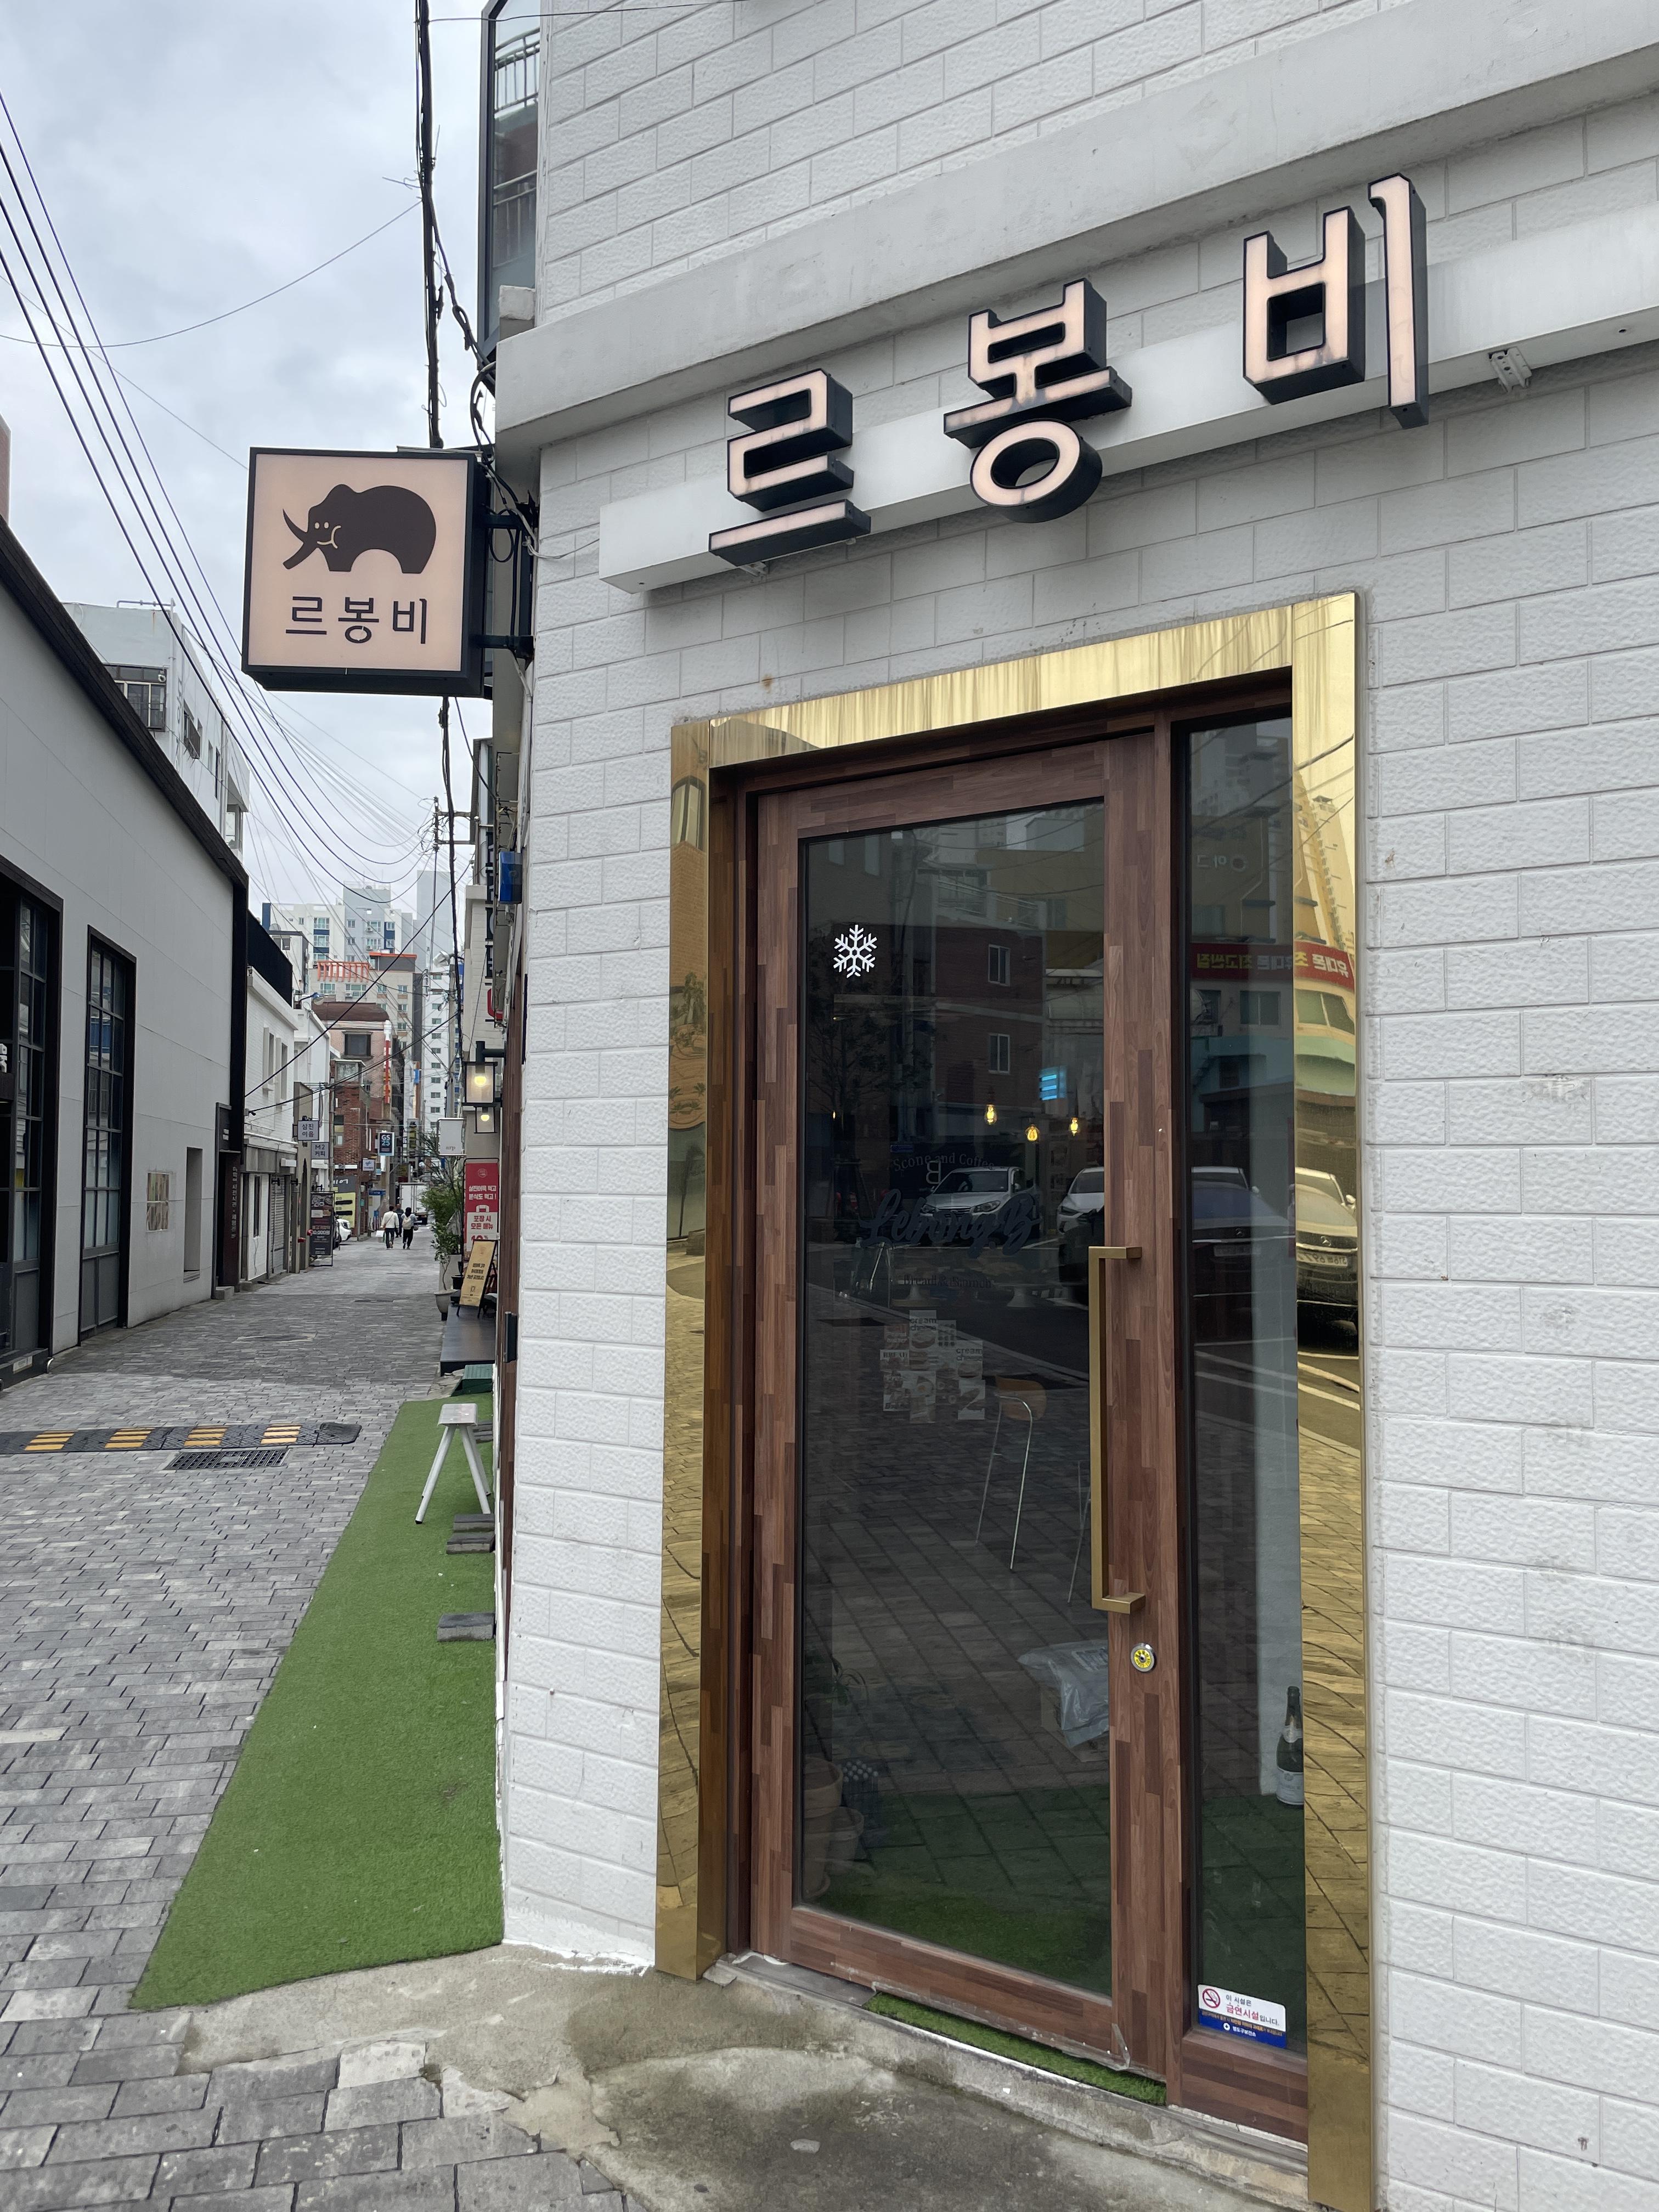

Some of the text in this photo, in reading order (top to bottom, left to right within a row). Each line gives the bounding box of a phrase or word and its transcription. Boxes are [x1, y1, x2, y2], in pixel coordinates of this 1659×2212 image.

[709, 173, 1426, 566] 르봉비
[285, 596, 427, 645] 르봉비
[893, 1155, 931, 1171] Scone
[1226, 1994, 1251, 2007] 이 시설은
